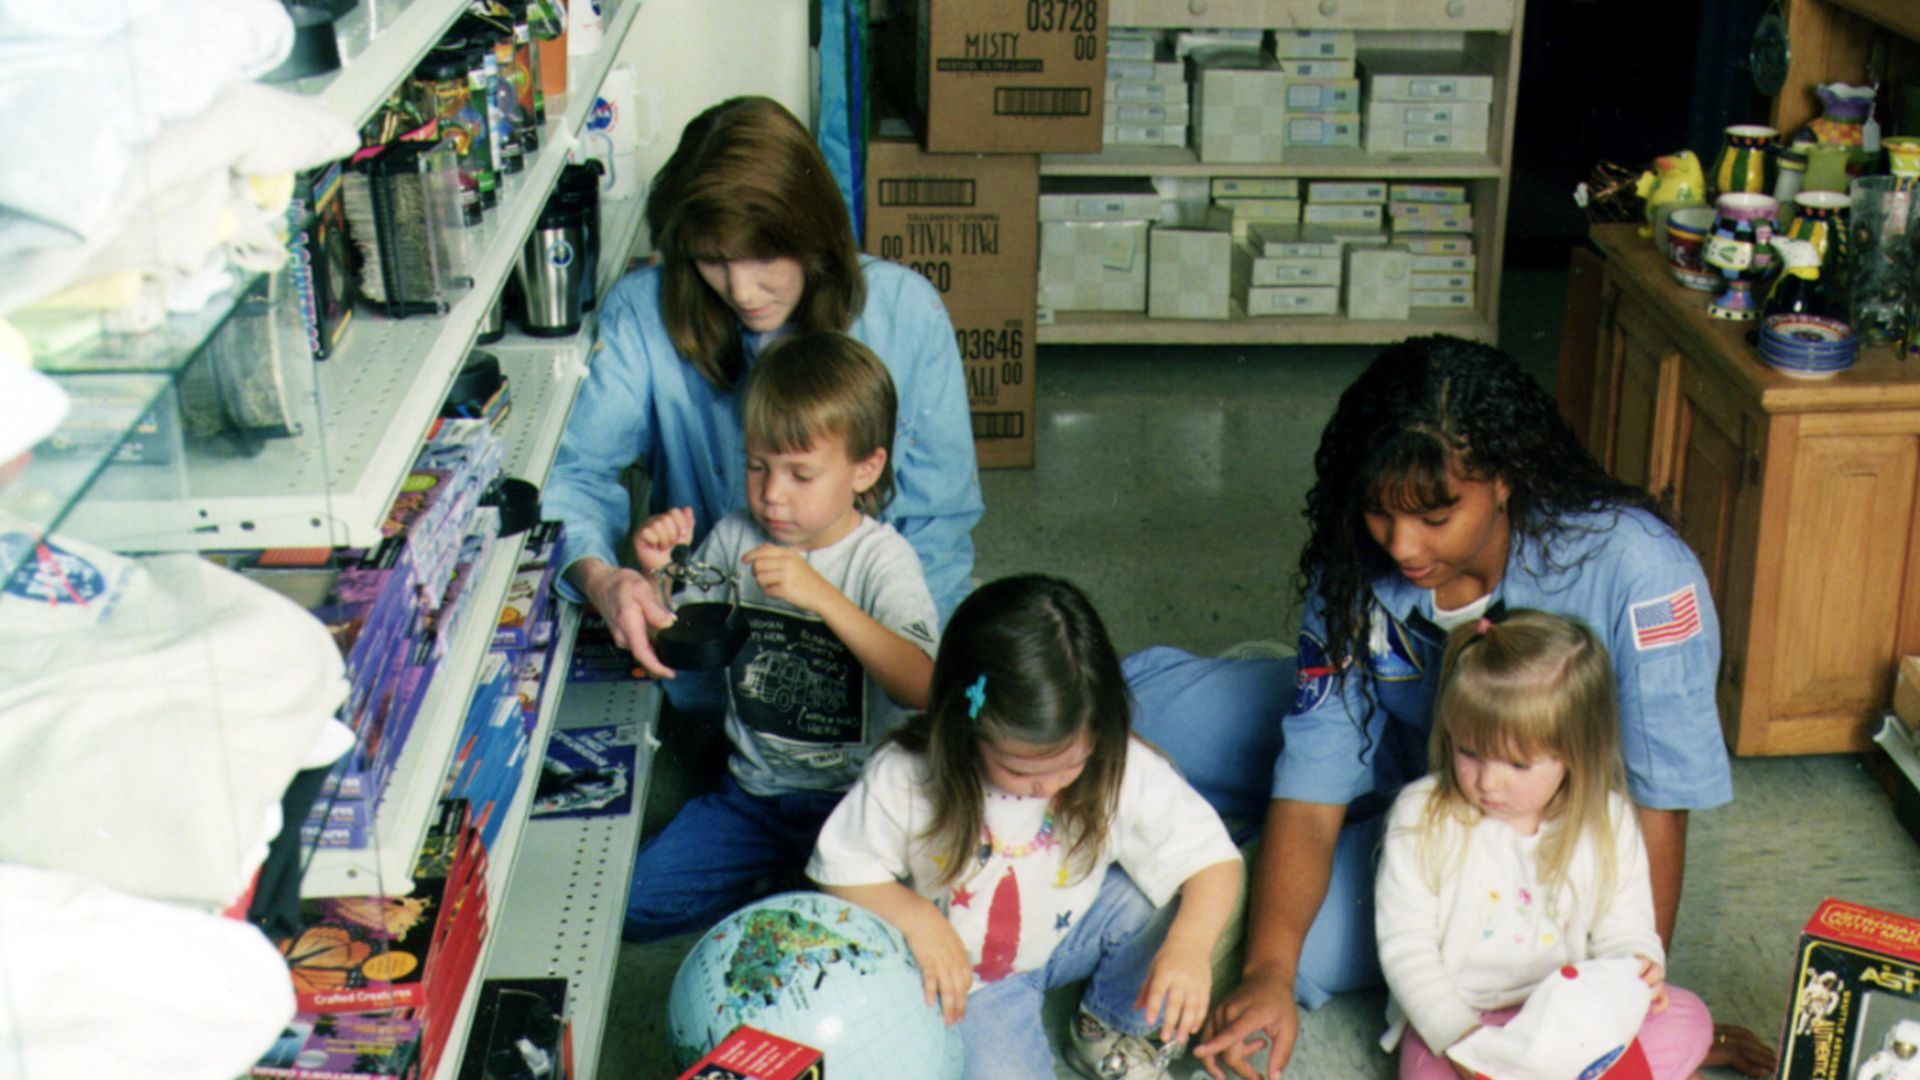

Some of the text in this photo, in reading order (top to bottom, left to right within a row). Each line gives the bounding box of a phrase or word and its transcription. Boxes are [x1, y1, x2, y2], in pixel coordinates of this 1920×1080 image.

[1027, 0, 1097, 31] 03728
[965, 32, 1020, 58] MISTY
[1074, 35, 1097, 60] 00
[880, 235, 903, 260] 00
[906, 223, 999, 255] PALL MALL
[956, 328, 1023, 360] 03646
[1002, 362, 1023, 385] 00
[313, 987, 413, 1006] Crafted Creatures
